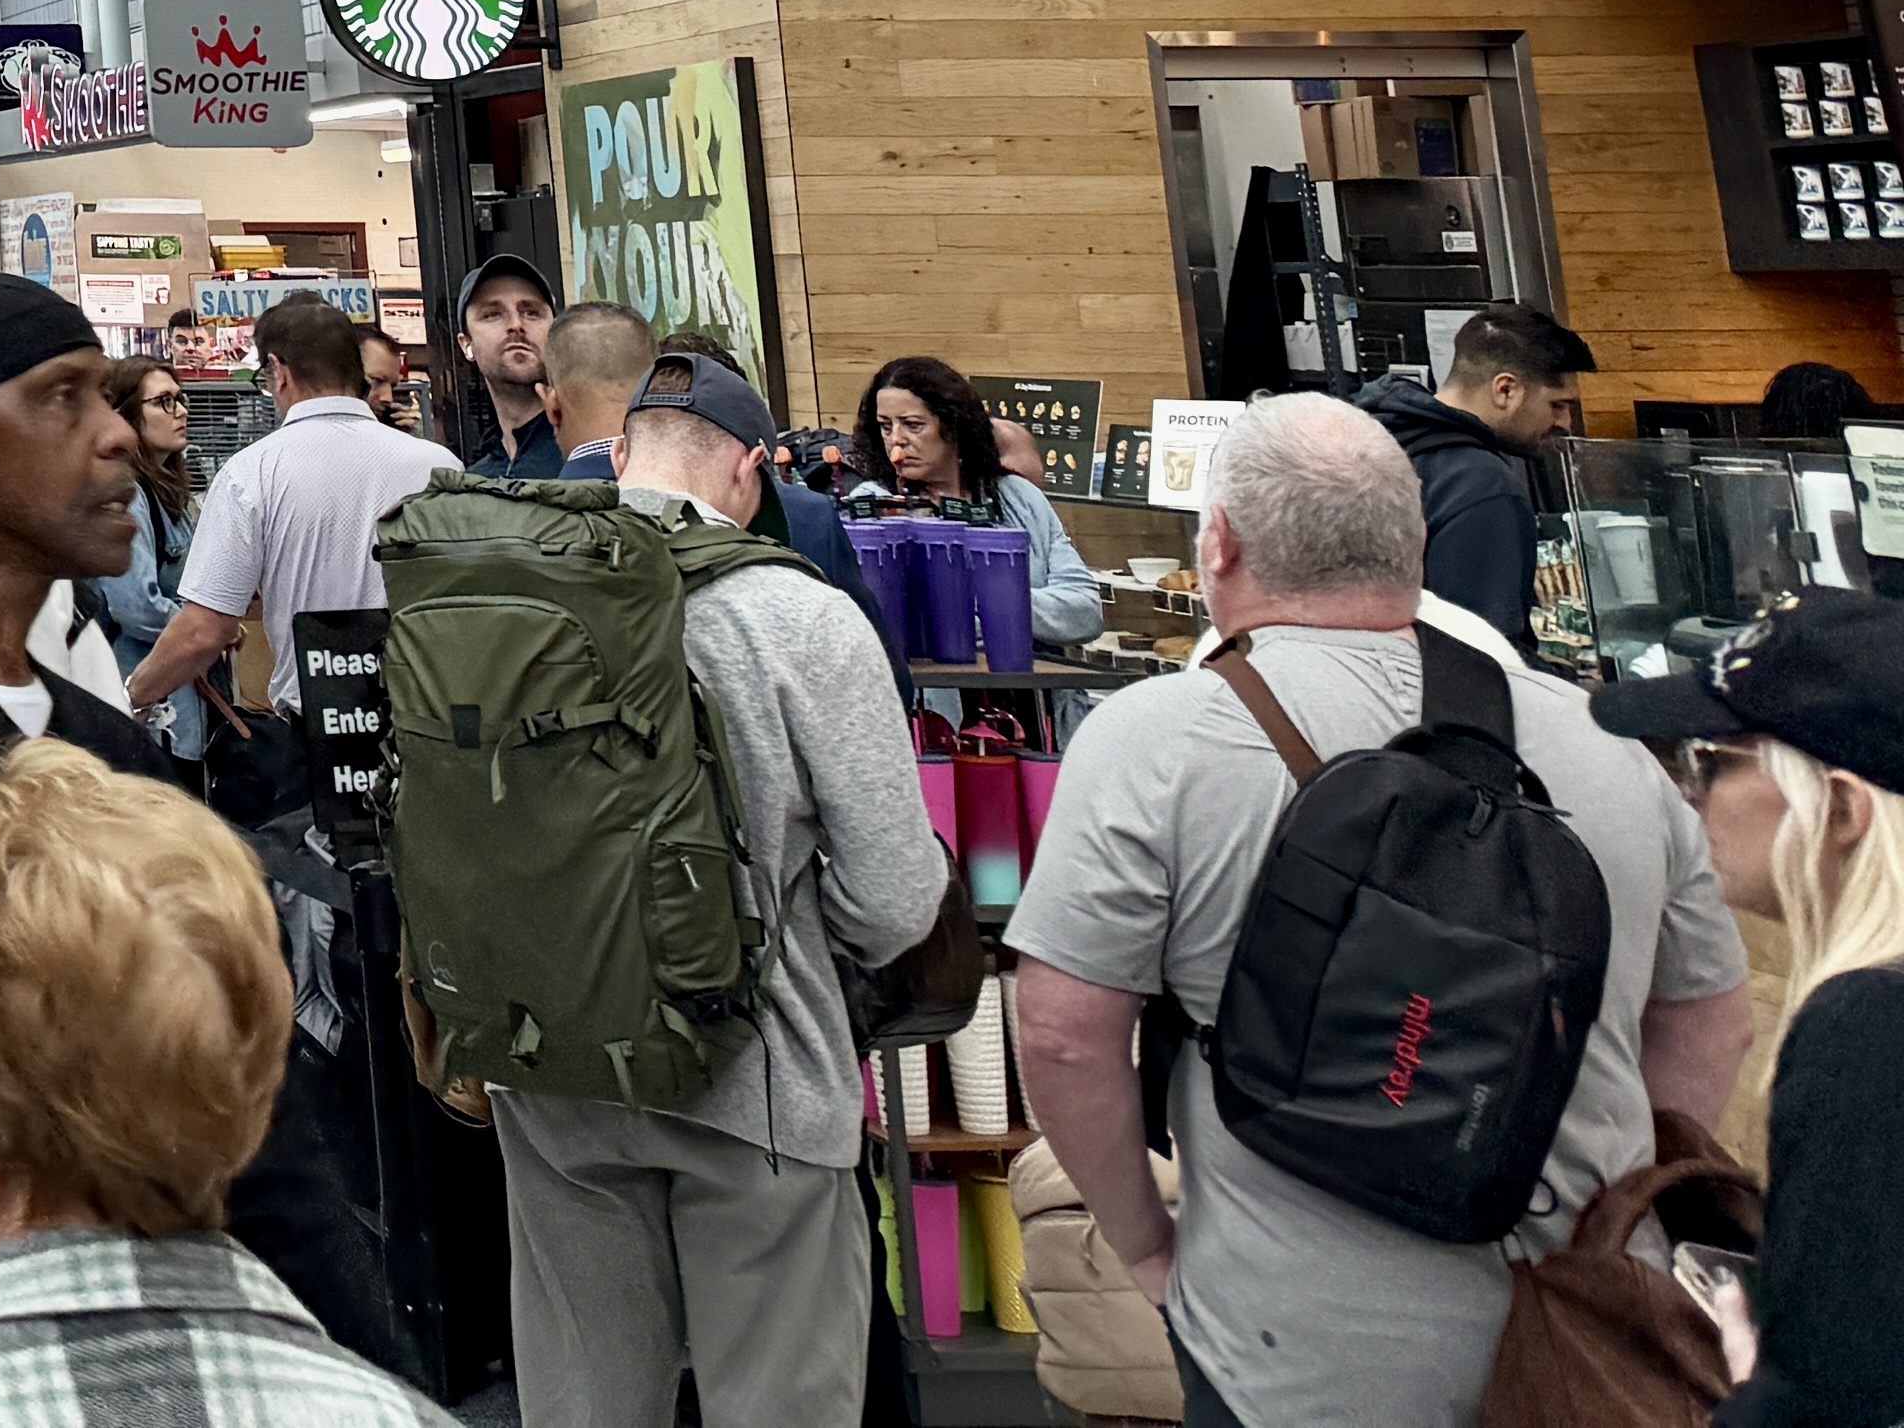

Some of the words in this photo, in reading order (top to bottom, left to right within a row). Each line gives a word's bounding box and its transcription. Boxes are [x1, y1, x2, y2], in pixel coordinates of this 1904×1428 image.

[151, 68, 308, 96] SMOOTHIE
[50, 61, 145, 145] SMOOTHIE
[583, 95, 720, 204] POUR
[130, 236, 156, 249] TASTY
[590, 220, 732, 326] YOUR
[201, 289, 270, 317] SALTY
[1168, 414, 1229, 428] PROTEIN
[307, 650, 380, 677] Pleas
[323, 706, 380, 734] Ente
[333, 765, 380, 793] Her
